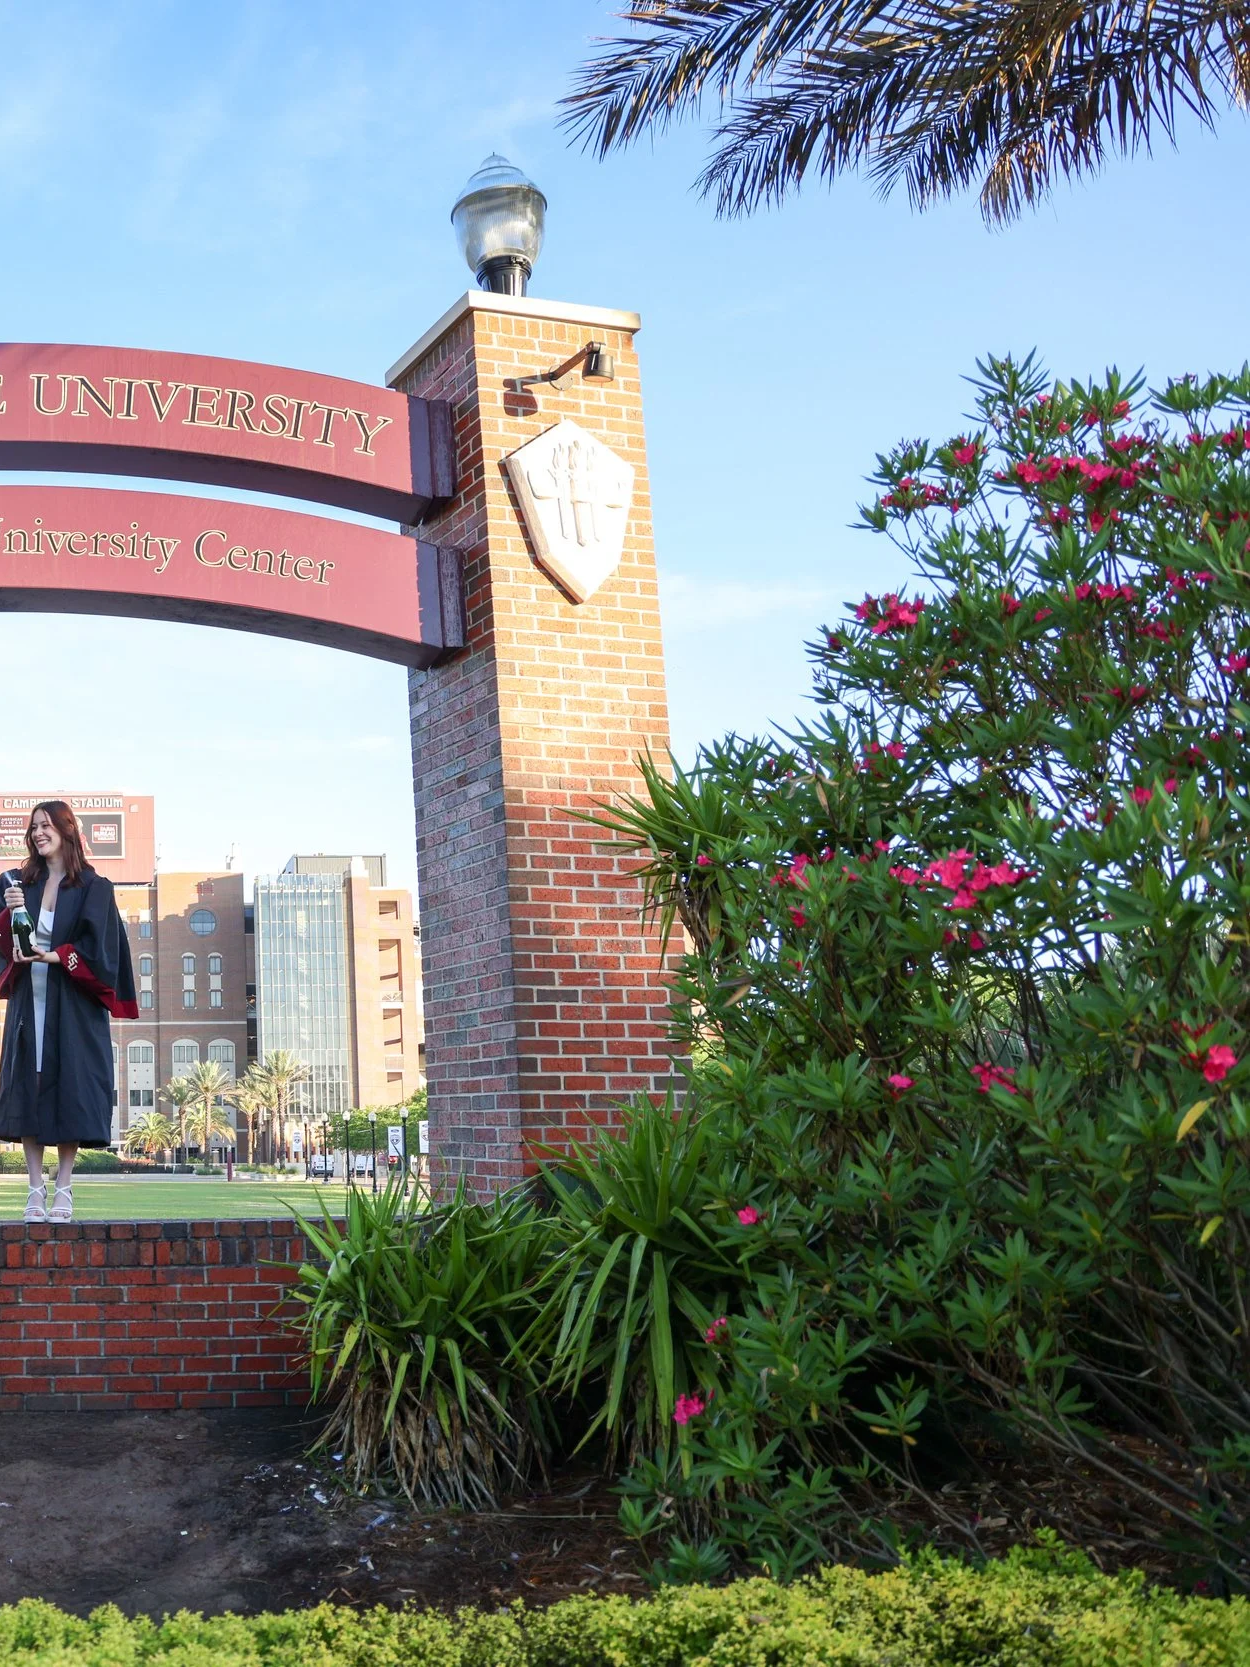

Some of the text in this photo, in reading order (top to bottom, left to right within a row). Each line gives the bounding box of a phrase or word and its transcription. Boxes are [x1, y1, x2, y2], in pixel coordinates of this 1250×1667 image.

[30, 373, 393, 456] UNIVERSITY
[194, 529, 336, 585] Center
[71, 798, 123, 808] STADIUM
